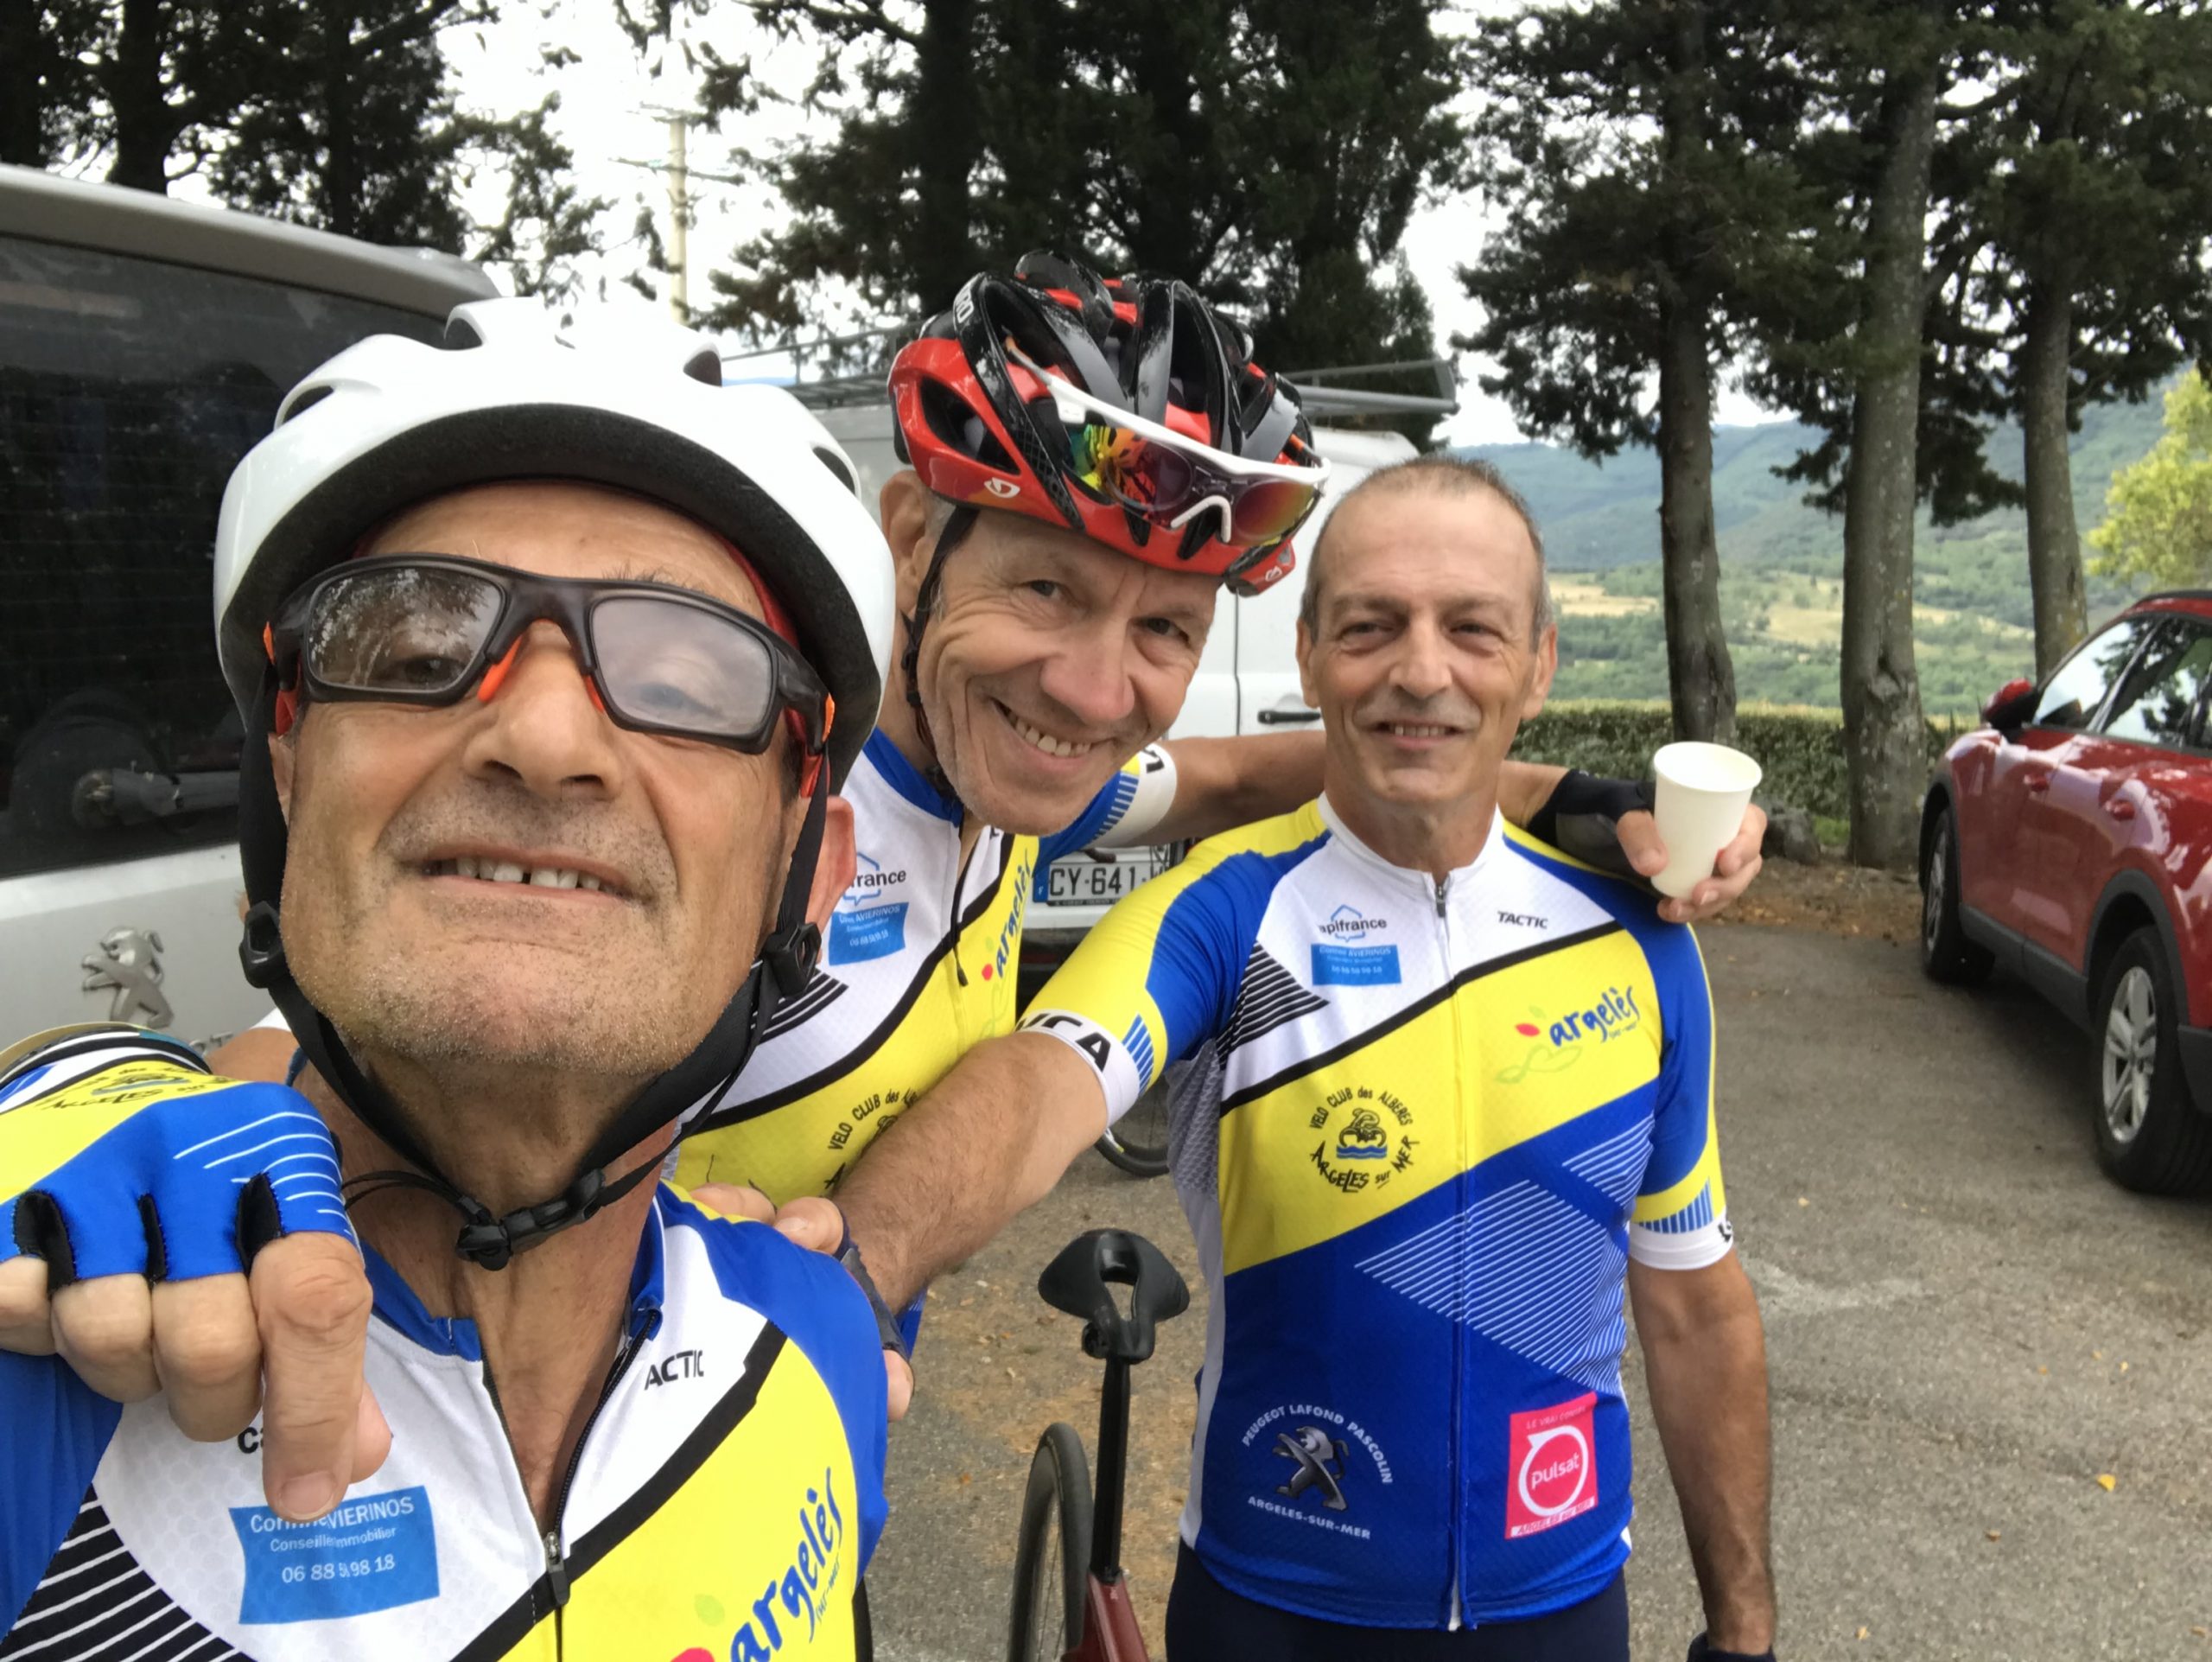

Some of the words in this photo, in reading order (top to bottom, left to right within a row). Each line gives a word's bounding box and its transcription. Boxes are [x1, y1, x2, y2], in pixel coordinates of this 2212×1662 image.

[1050, 865, 1166, 896] CY-641-
[1497, 910, 1548, 929] TACTIC
[828, 1122, 853, 1150] VELO
[851, 1093, 880, 1122] CLUB
[885, 1089, 899, 1105] des
[1309, 1106, 1329, 1130] VELO
[1326, 1087, 1353, 1108] CLUB
[1357, 1086, 1373, 1098] des
[1377, 1091, 1414, 1126] ALBERES
[1309, 1140, 1370, 1193] ARGELES
[1375, 1170, 1391, 1185] sur
[1390, 1135, 1420, 1174] MER
[1242, 1406, 1285, 1447] PEUGEOT
[1289, 1404, 1344, 1425] LAFOND
[1346, 1422, 1393, 1485] PASCOLIN
[1531, 1452, 1580, 1490] pulsat
[327, 1496, 414, 1530] VIERINOS
[1248, 1495, 1371, 1539] ARGELES-SUR-MER
[334, 1526, 397, 1548] mmobilier
[282, 1566, 305, 1583] 06
[311, 1563, 334, 1581] 88
[350, 1559, 371, 1576] 98
[374, 1553, 395, 1572] 18
